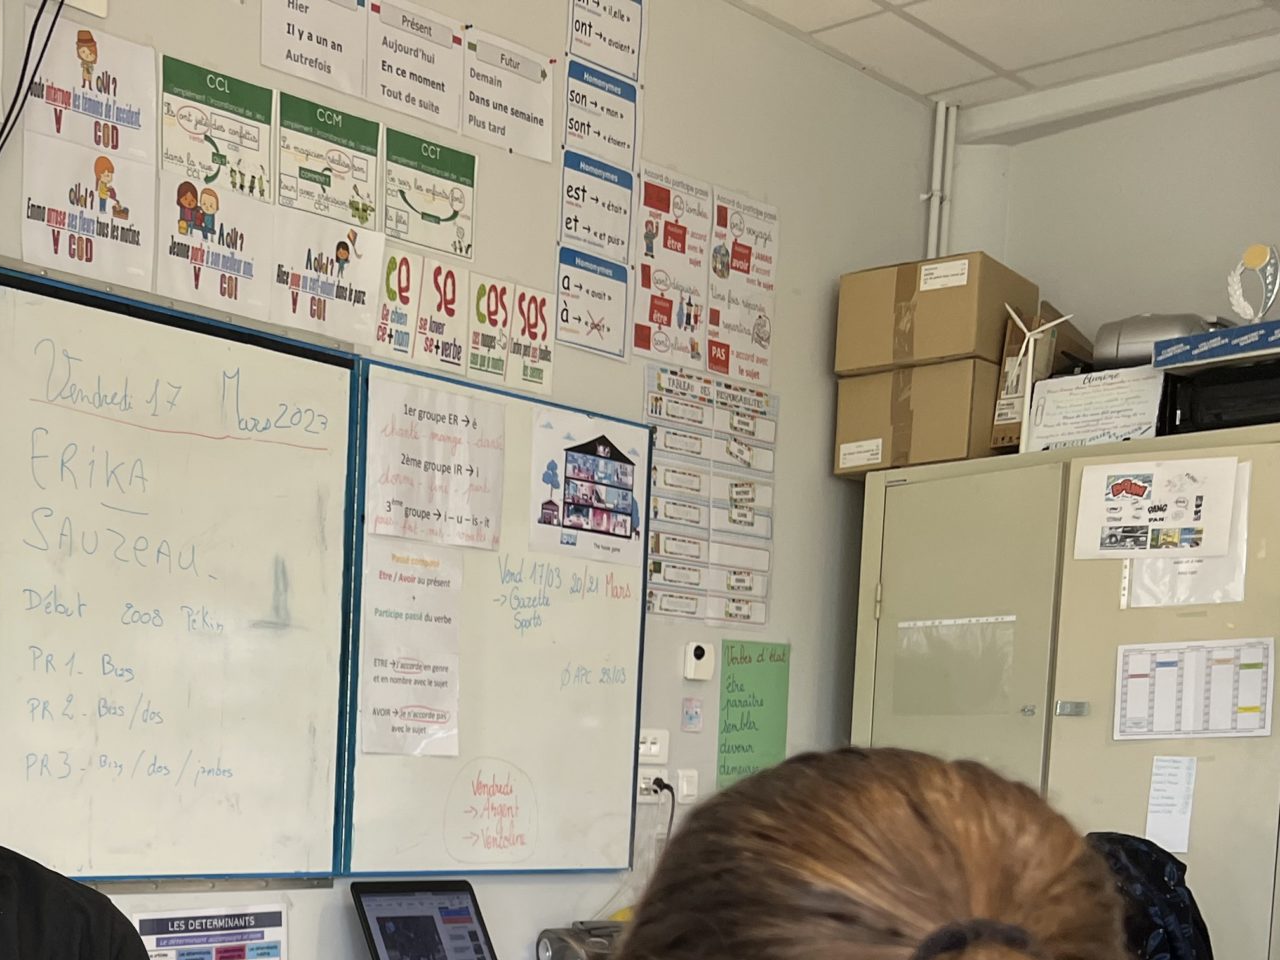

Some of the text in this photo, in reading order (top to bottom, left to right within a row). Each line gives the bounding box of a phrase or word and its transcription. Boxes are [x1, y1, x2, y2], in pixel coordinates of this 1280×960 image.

[401, 14, 432, 37] Présent
[574, 18, 593, 38] ont
[286, 22, 343, 53] Il y a un an
[381, 35, 435, 65] Aujourd'hui
[286, 49, 332, 75] Autrefois
[500, 54, 520, 71] Futur
[207, 74, 230, 93] CCL
[381, 60, 445, 93] En ce moment
[469, 67, 502, 88] Demain
[583, 71, 622, 95] Homonymes
[380, 84, 440, 115] Tout de suite
[469, 90, 490, 108] Dans
[492, 99, 509, 114] une
[510, 104, 544, 127] semaine
[569, 89, 587, 107] son
[316, 109, 343, 128] CCM
[468, 114, 506, 136] Plus tard
[568, 117, 591, 136] sont
[94, 120, 119, 150] COD
[421, 143, 441, 160] CCT
[579, 161, 618, 183] Homonymes
[566, 184, 588, 203] est
[565, 215, 579, 233] et
[69, 234, 93, 263] COD
[666, 237, 682, 252] être
[575, 256, 613, 277] Homonymes
[731, 256, 749, 272] avoir
[385, 256, 410, 305] ce
[433, 265, 456, 317] se
[562, 275, 570, 291] a
[476, 283, 508, 328] ces
[517, 291, 548, 342] ses
[560, 300, 569, 324] à
[652, 308, 668, 325] être
[440, 338, 462, 361] verbe
[711, 346, 726, 361] PAS
[34, 338, 330, 434] Vendredi 17 Mars 2023
[404, 404, 459, 426] 1er groupe ER
[400, 453, 463, 476] 2ème groupe IR
[404, 506, 431, 520] groupe
[378, 570, 451, 588] Etre Avoir au présent
[530, 561, 562, 597] 17/03
[605, 572, 632, 600] Mars
[23, 586, 164, 629] Début 2008
[509, 586, 551, 611] Gazette
[374, 608, 452, 624] Participe du verbe
[514, 611, 543, 637] Sports
[29, 646, 57, 674] PR
[373, 658, 388, 668] ETRE
[431, 664, 449, 674] genre
[724, 645, 753, 666] Verbes
[389, 676, 448, 689] nombre avec le sujet
[726, 673, 745, 693] être
[27, 697, 54, 722] PR
[372, 708, 391, 718] AVOIR
[721, 691, 764, 720] paraître
[391, 724, 426, 734] avec le sujet
[26, 752, 53, 781] PR
[472, 769, 517, 797] Vendredi
[479, 795, 520, 836] Argent
[168, 916, 255, 932] LES DETERMINANTS
